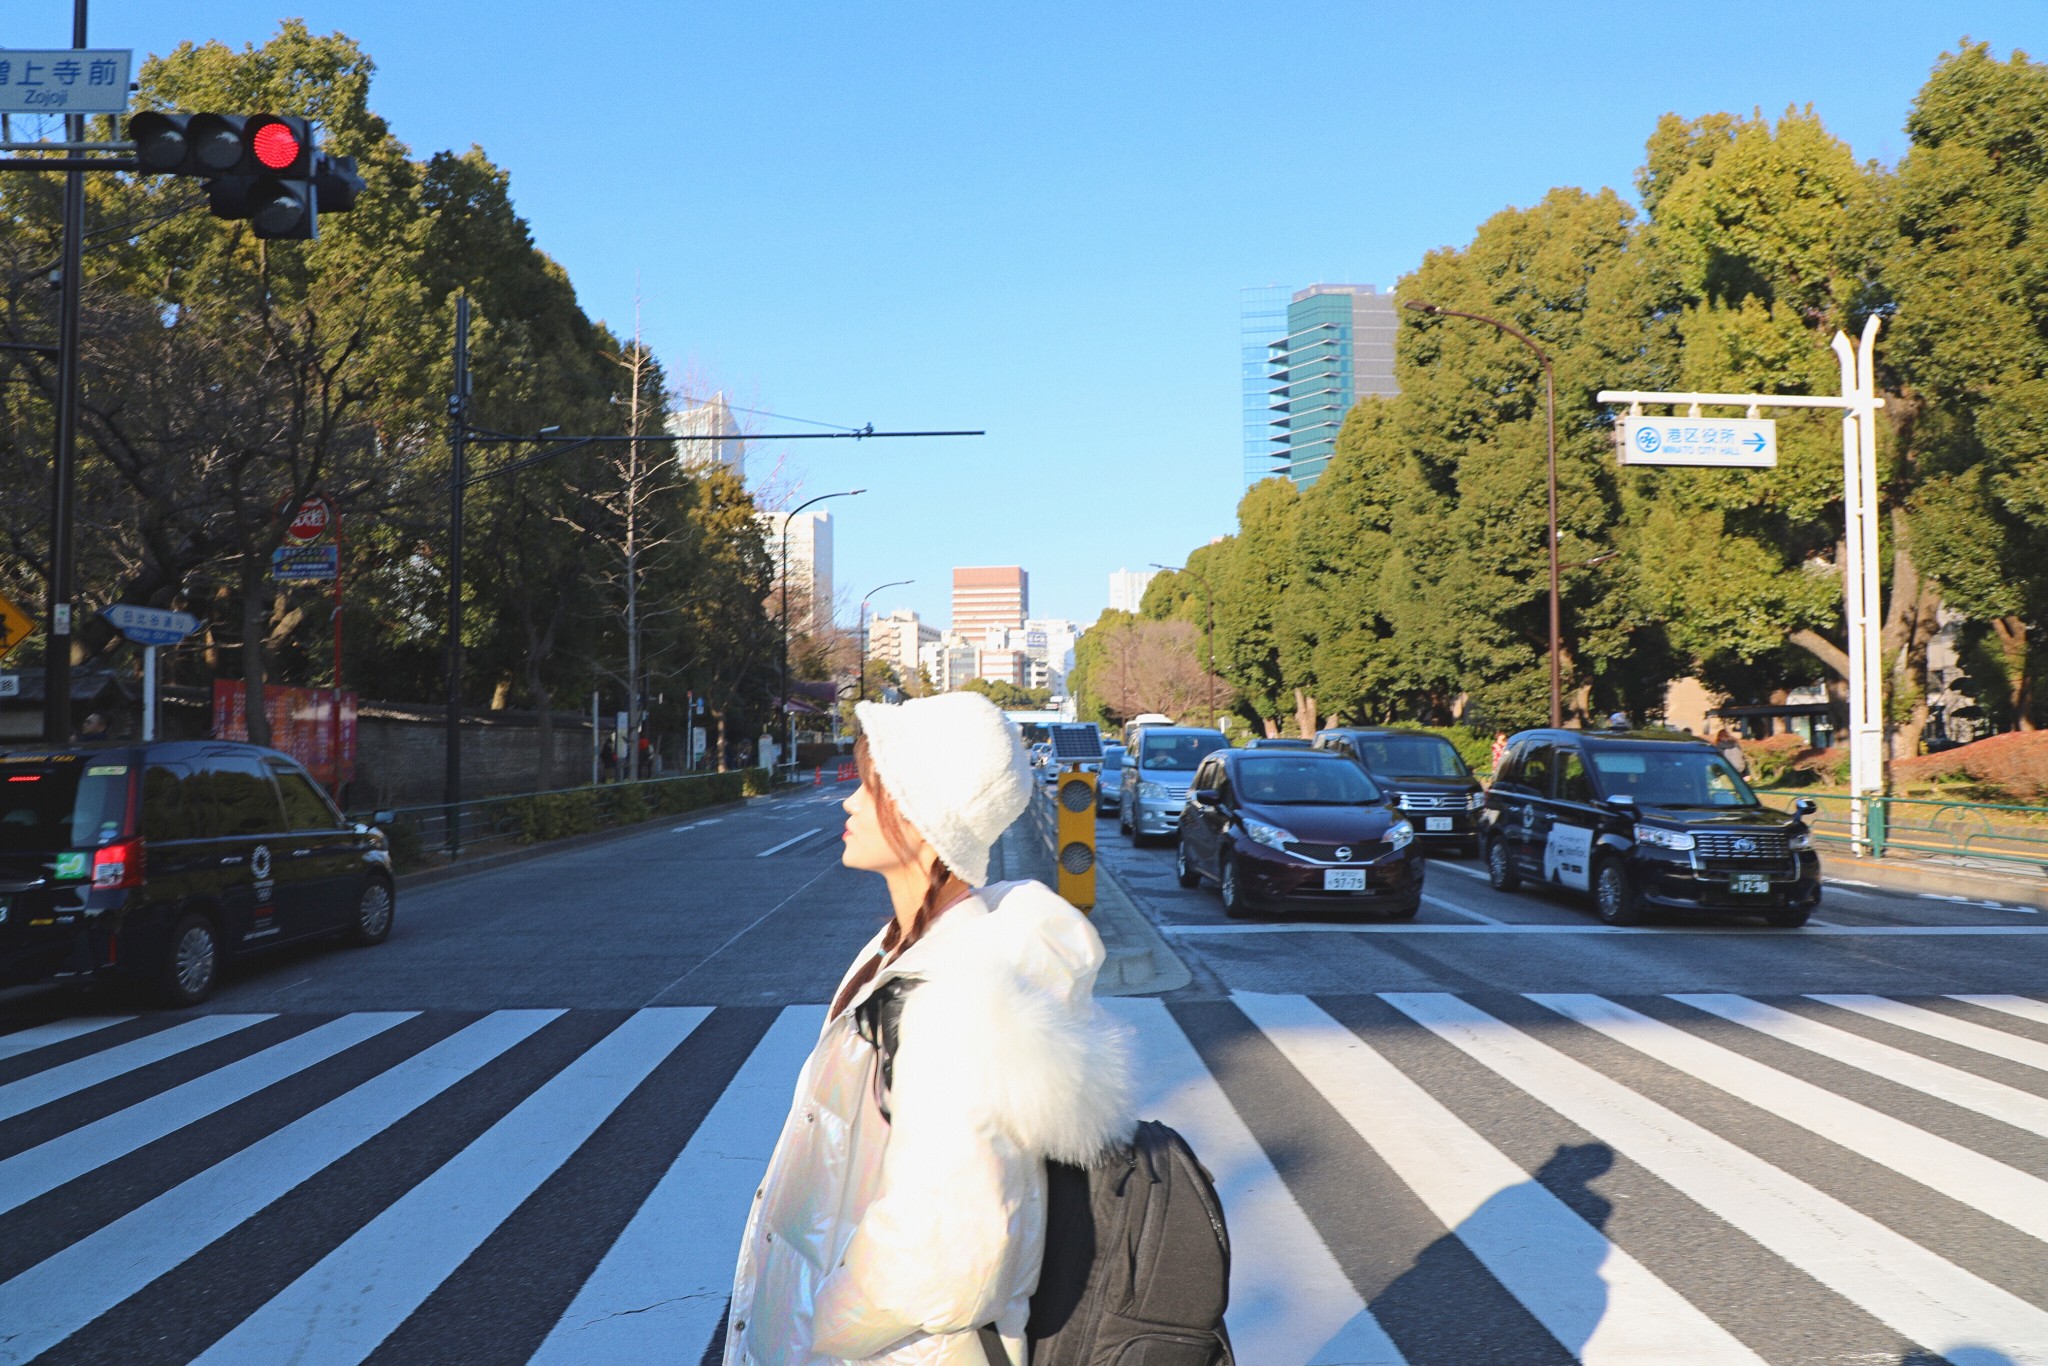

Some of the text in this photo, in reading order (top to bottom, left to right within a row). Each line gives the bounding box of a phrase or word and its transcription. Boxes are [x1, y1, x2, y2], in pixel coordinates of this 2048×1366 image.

[25, 89, 69, 107] Zojoji
[1667, 427, 1736, 444] 港区役所
